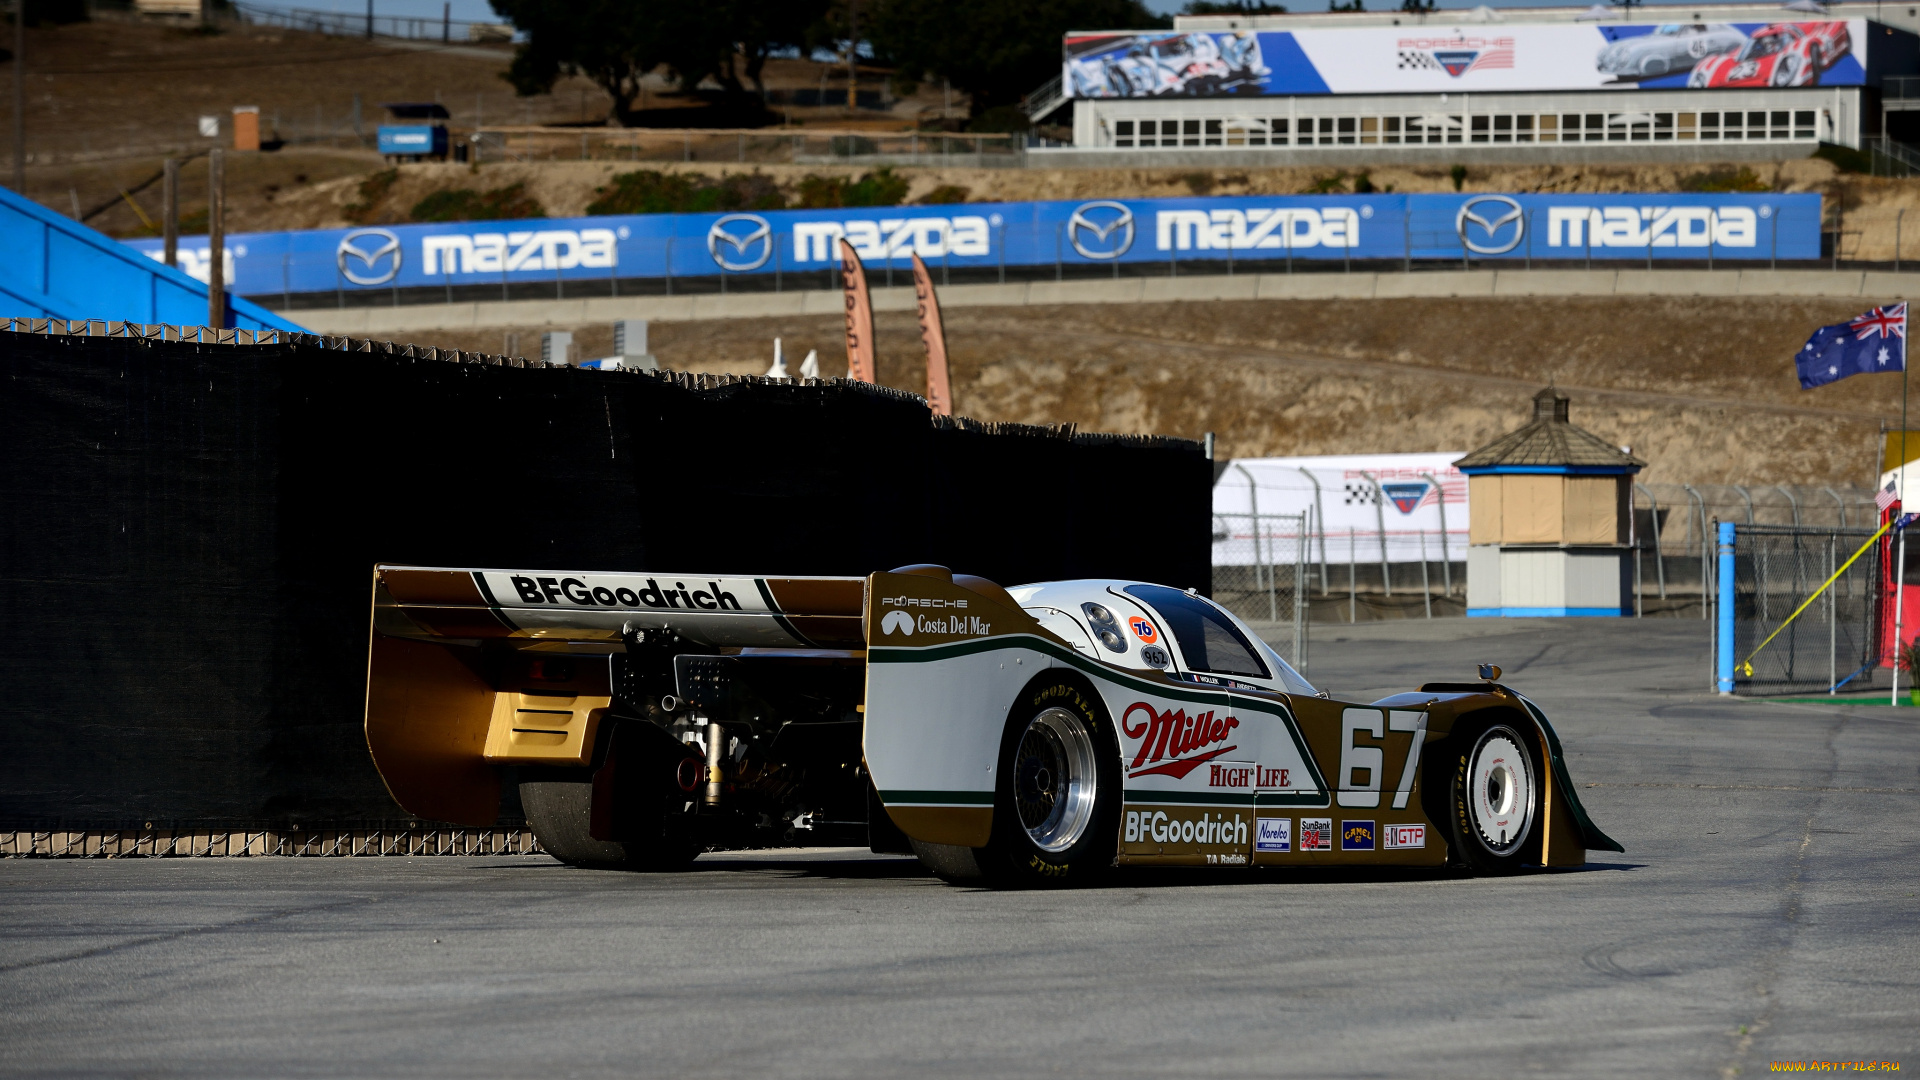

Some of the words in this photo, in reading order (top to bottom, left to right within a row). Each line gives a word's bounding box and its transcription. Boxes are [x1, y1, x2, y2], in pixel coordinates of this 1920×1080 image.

[1397, 37, 1515, 49] PORSCHE
[510, 575, 743, 611] BFGoodrich
[882, 597, 968, 608] PORSCHE
[917, 613, 947, 634] Costa
[950, 615, 967, 635] Del
[970, 616, 991, 636] Mar
[1132, 621, 1153, 637] 76
[1144, 650, 1168, 666] 962
[1122, 702, 1240, 769] Miller
[1336, 706, 1429, 809] 67
[1208, 764, 1249, 787] HIGH
[1124, 810, 1248, 845] BFGoodrich
[1258, 821, 1288, 841] Norelco
[1301, 820, 1330, 830] SunBank
[1344, 827, 1372, 840] CAMEL
[1302, 830, 1320, 849] 24
[1398, 828, 1424, 844] GTP
[1029, 854, 1069, 877] EAGLE
[1206, 854, 1218, 864] T/A
[1220, 854, 1246, 864] Radials
